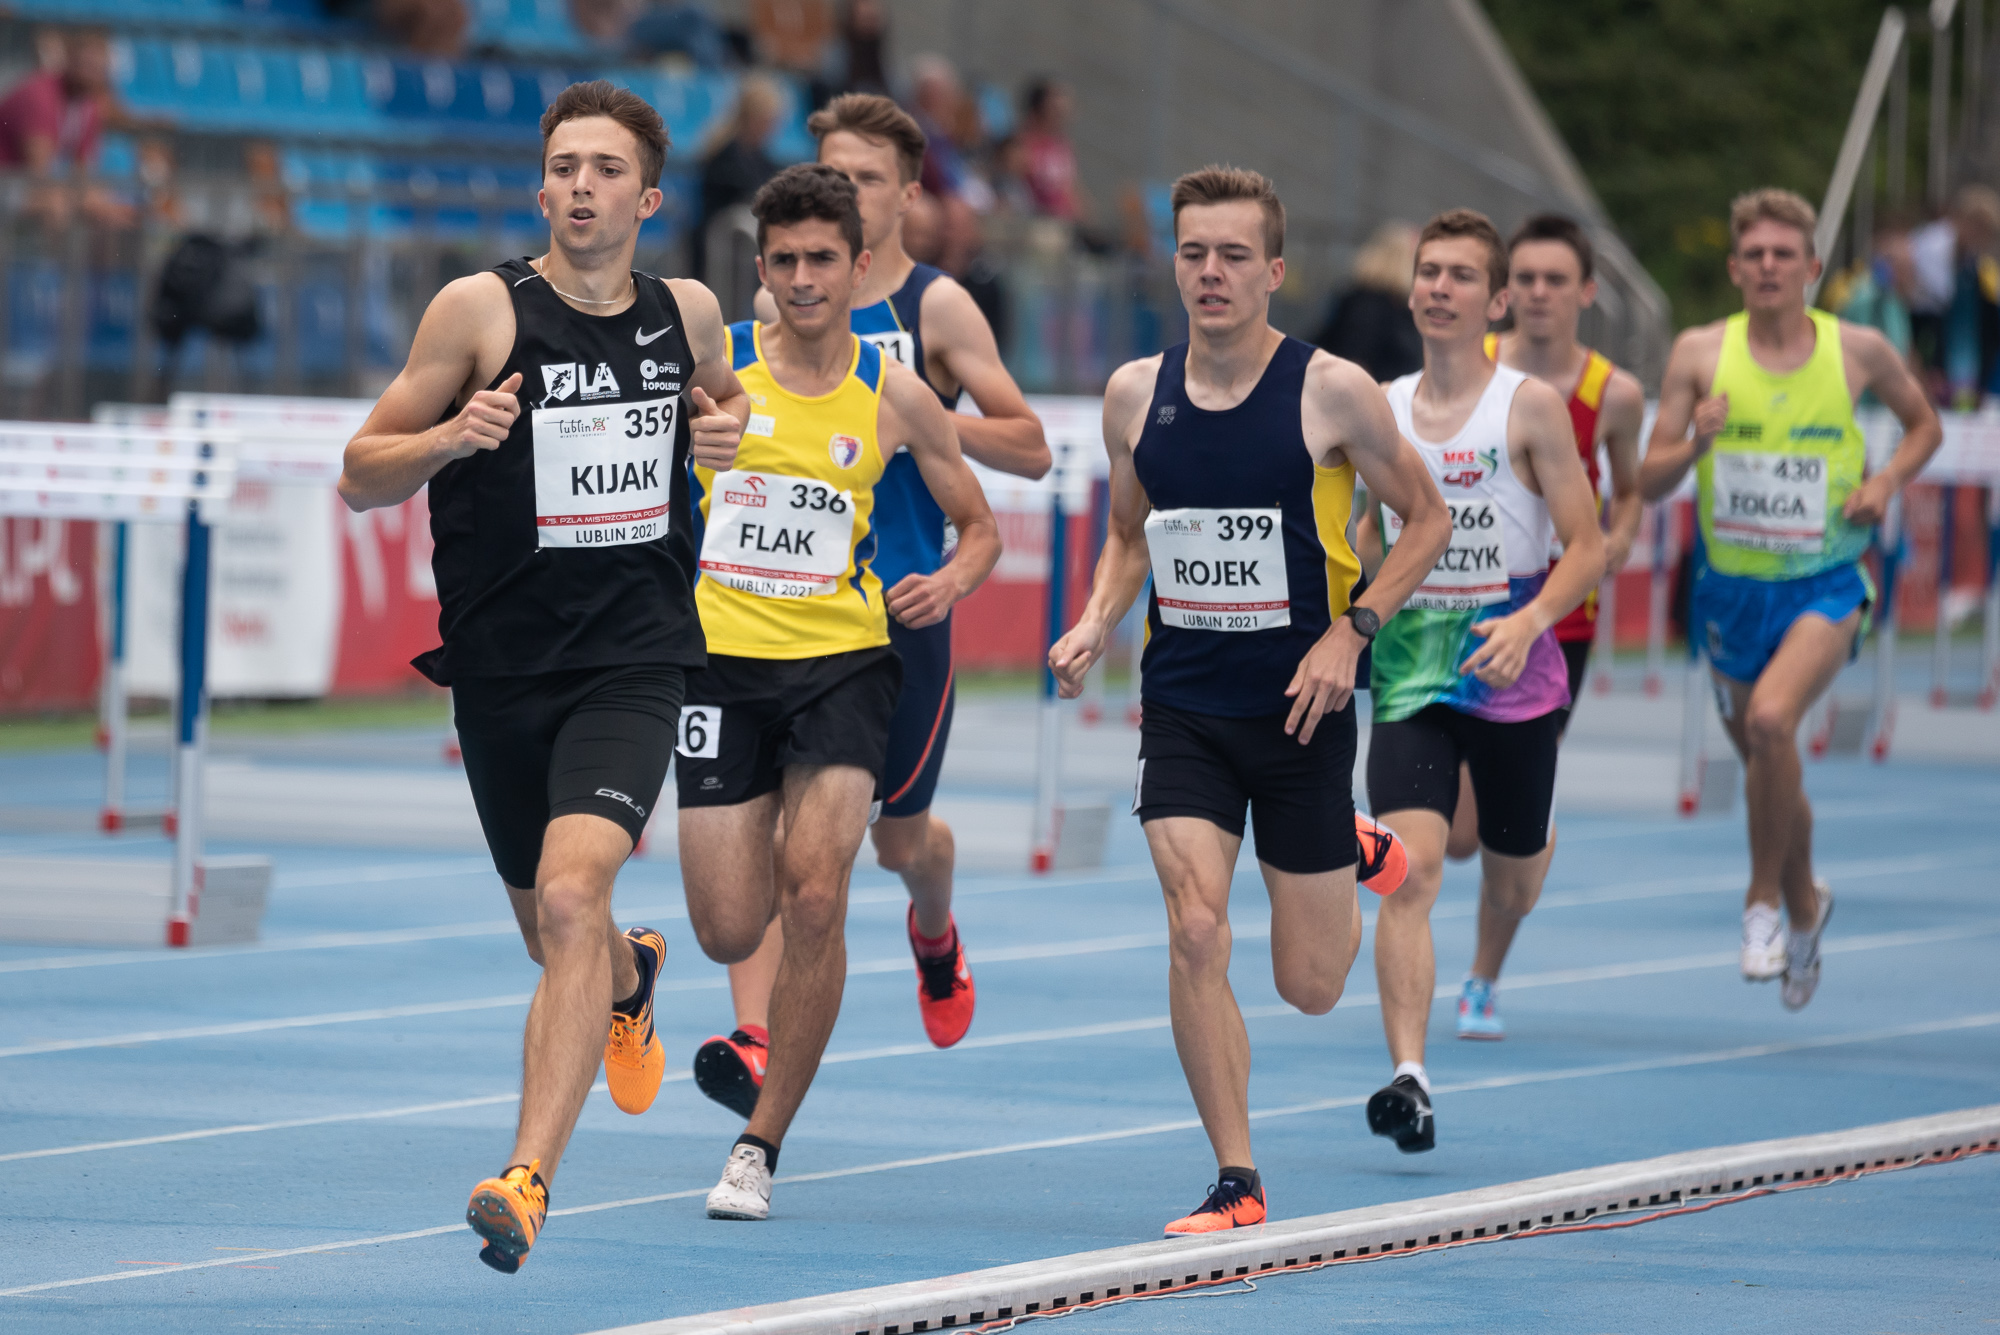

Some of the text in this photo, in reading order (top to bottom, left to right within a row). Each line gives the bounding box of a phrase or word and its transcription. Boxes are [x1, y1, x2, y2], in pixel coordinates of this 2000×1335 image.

[659, 365, 680, 374] OPOLE
[648, 381, 681, 391] OPOLSKIE
[624, 404, 673, 439] 359
[1443, 451, 1475, 465] MKS
[571, 458, 659, 496] KIJAK
[1774, 458, 1820, 483] 430
[726, 493, 765, 506] ORLEN
[790, 484, 847, 514] 336
[584, 512, 642, 523] MISTRZOSTWA
[1217, 515, 1273, 541] 399
[1448, 505, 1494, 529] 266
[576, 522, 657, 543] LUBLIN 2021
[739, 523, 815, 556] FLAK
[1174, 559, 1261, 586] ROJEK
[730, 578, 813, 597] LUBLIN 2021
[1410, 598, 1479, 611] LUBLIN 2021
[1183, 613, 1258, 628] LUBLIN 2021
[686, 711, 708, 753] 6
